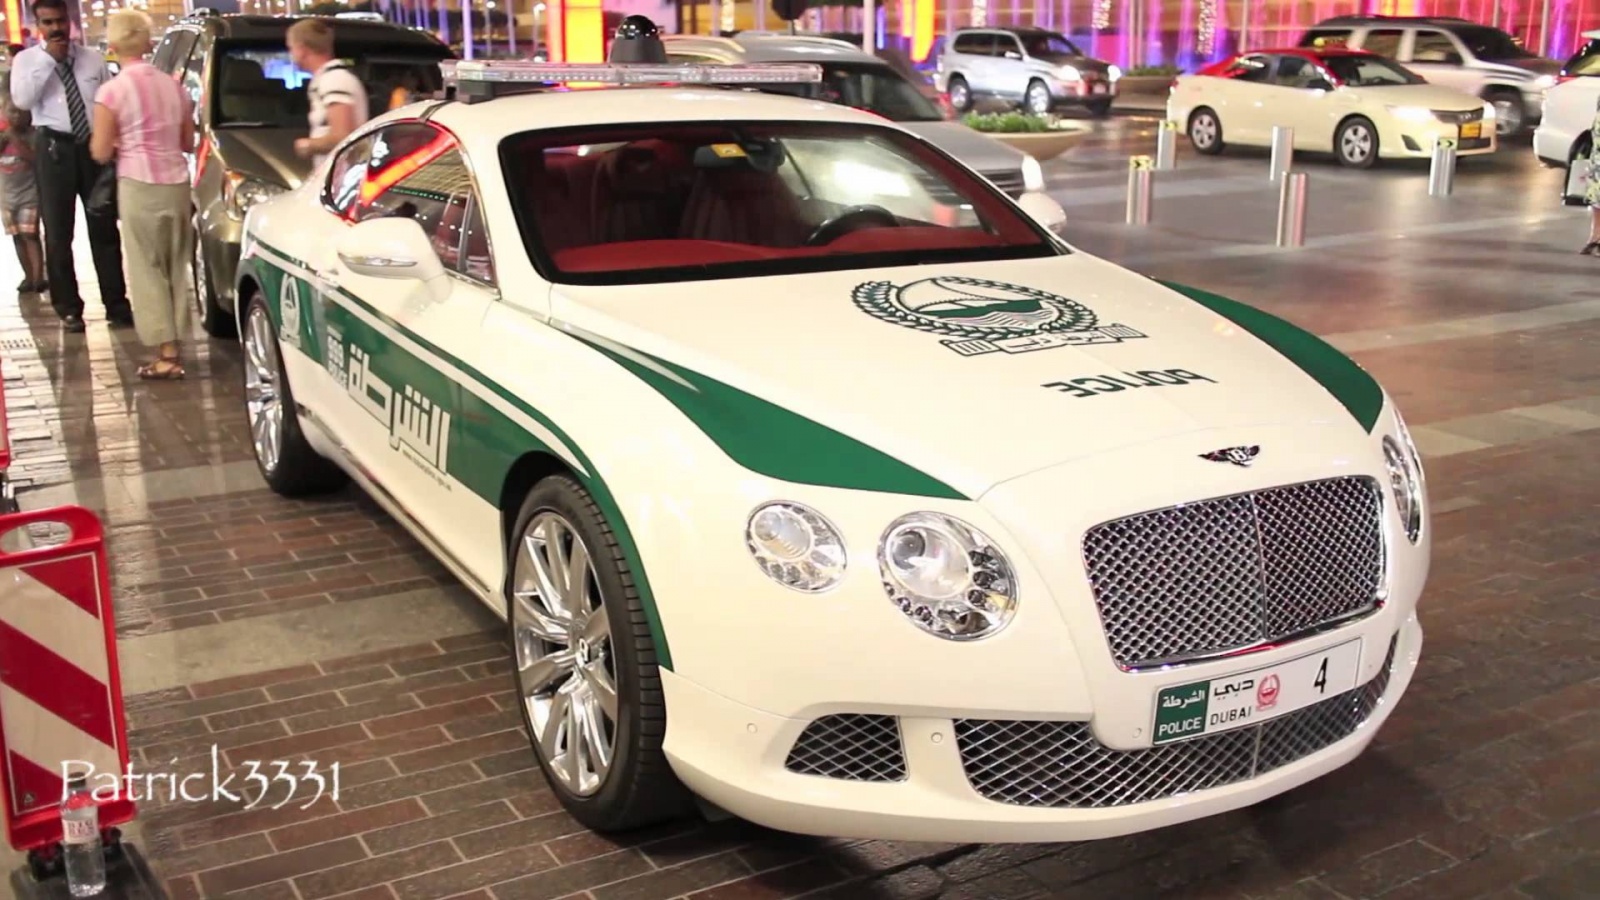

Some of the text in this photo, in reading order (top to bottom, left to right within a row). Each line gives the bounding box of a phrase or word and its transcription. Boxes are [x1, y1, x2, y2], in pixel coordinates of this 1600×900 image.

[350, 343, 451, 477] الشرطة
[1313, 657, 1329, 694] 4
[1162, 689, 1206, 709] الشرطة
[1214, 679, 1255, 701] دبي
[1209, 706, 1252, 726] DUBAI
[1158, 717, 1203, 737] POLICE
